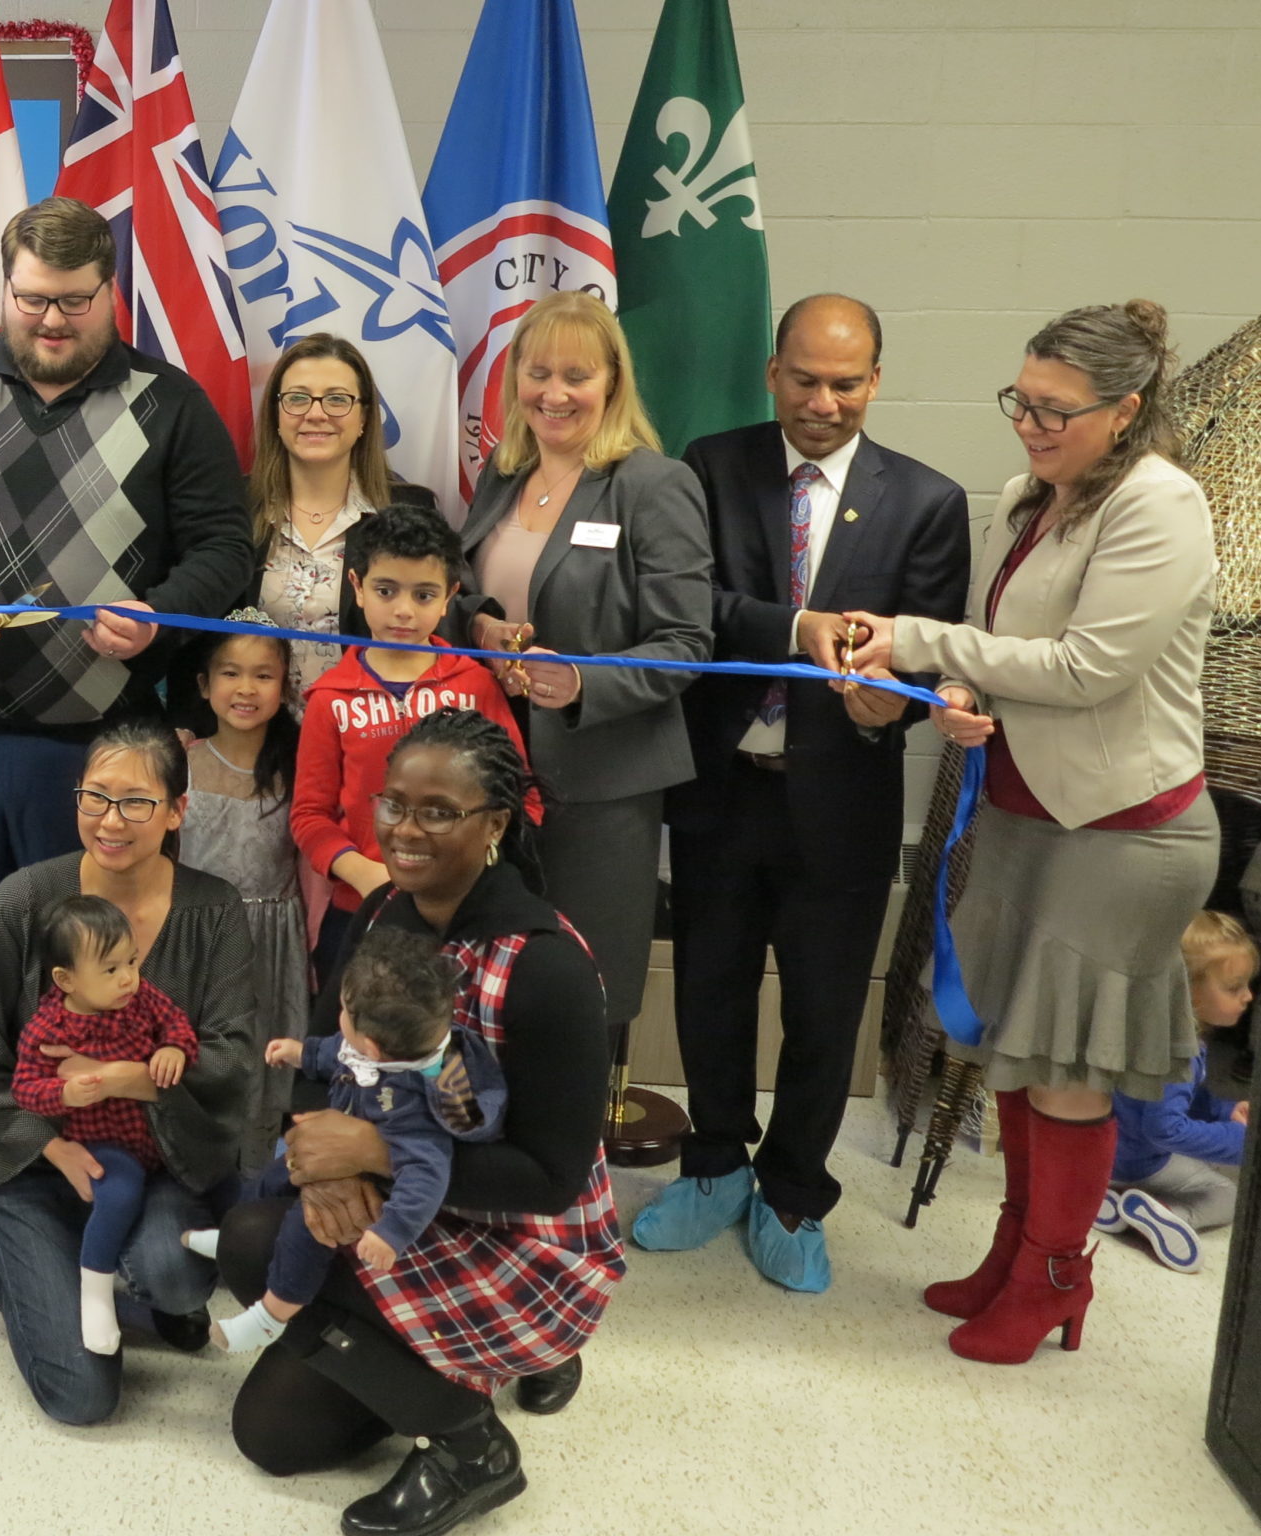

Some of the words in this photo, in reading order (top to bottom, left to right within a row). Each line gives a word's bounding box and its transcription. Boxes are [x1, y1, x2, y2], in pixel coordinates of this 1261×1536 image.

[494, 252, 569, 291] CITY
[465, 412, 482, 464] 1971
[370, 725, 400, 739] SINCE
